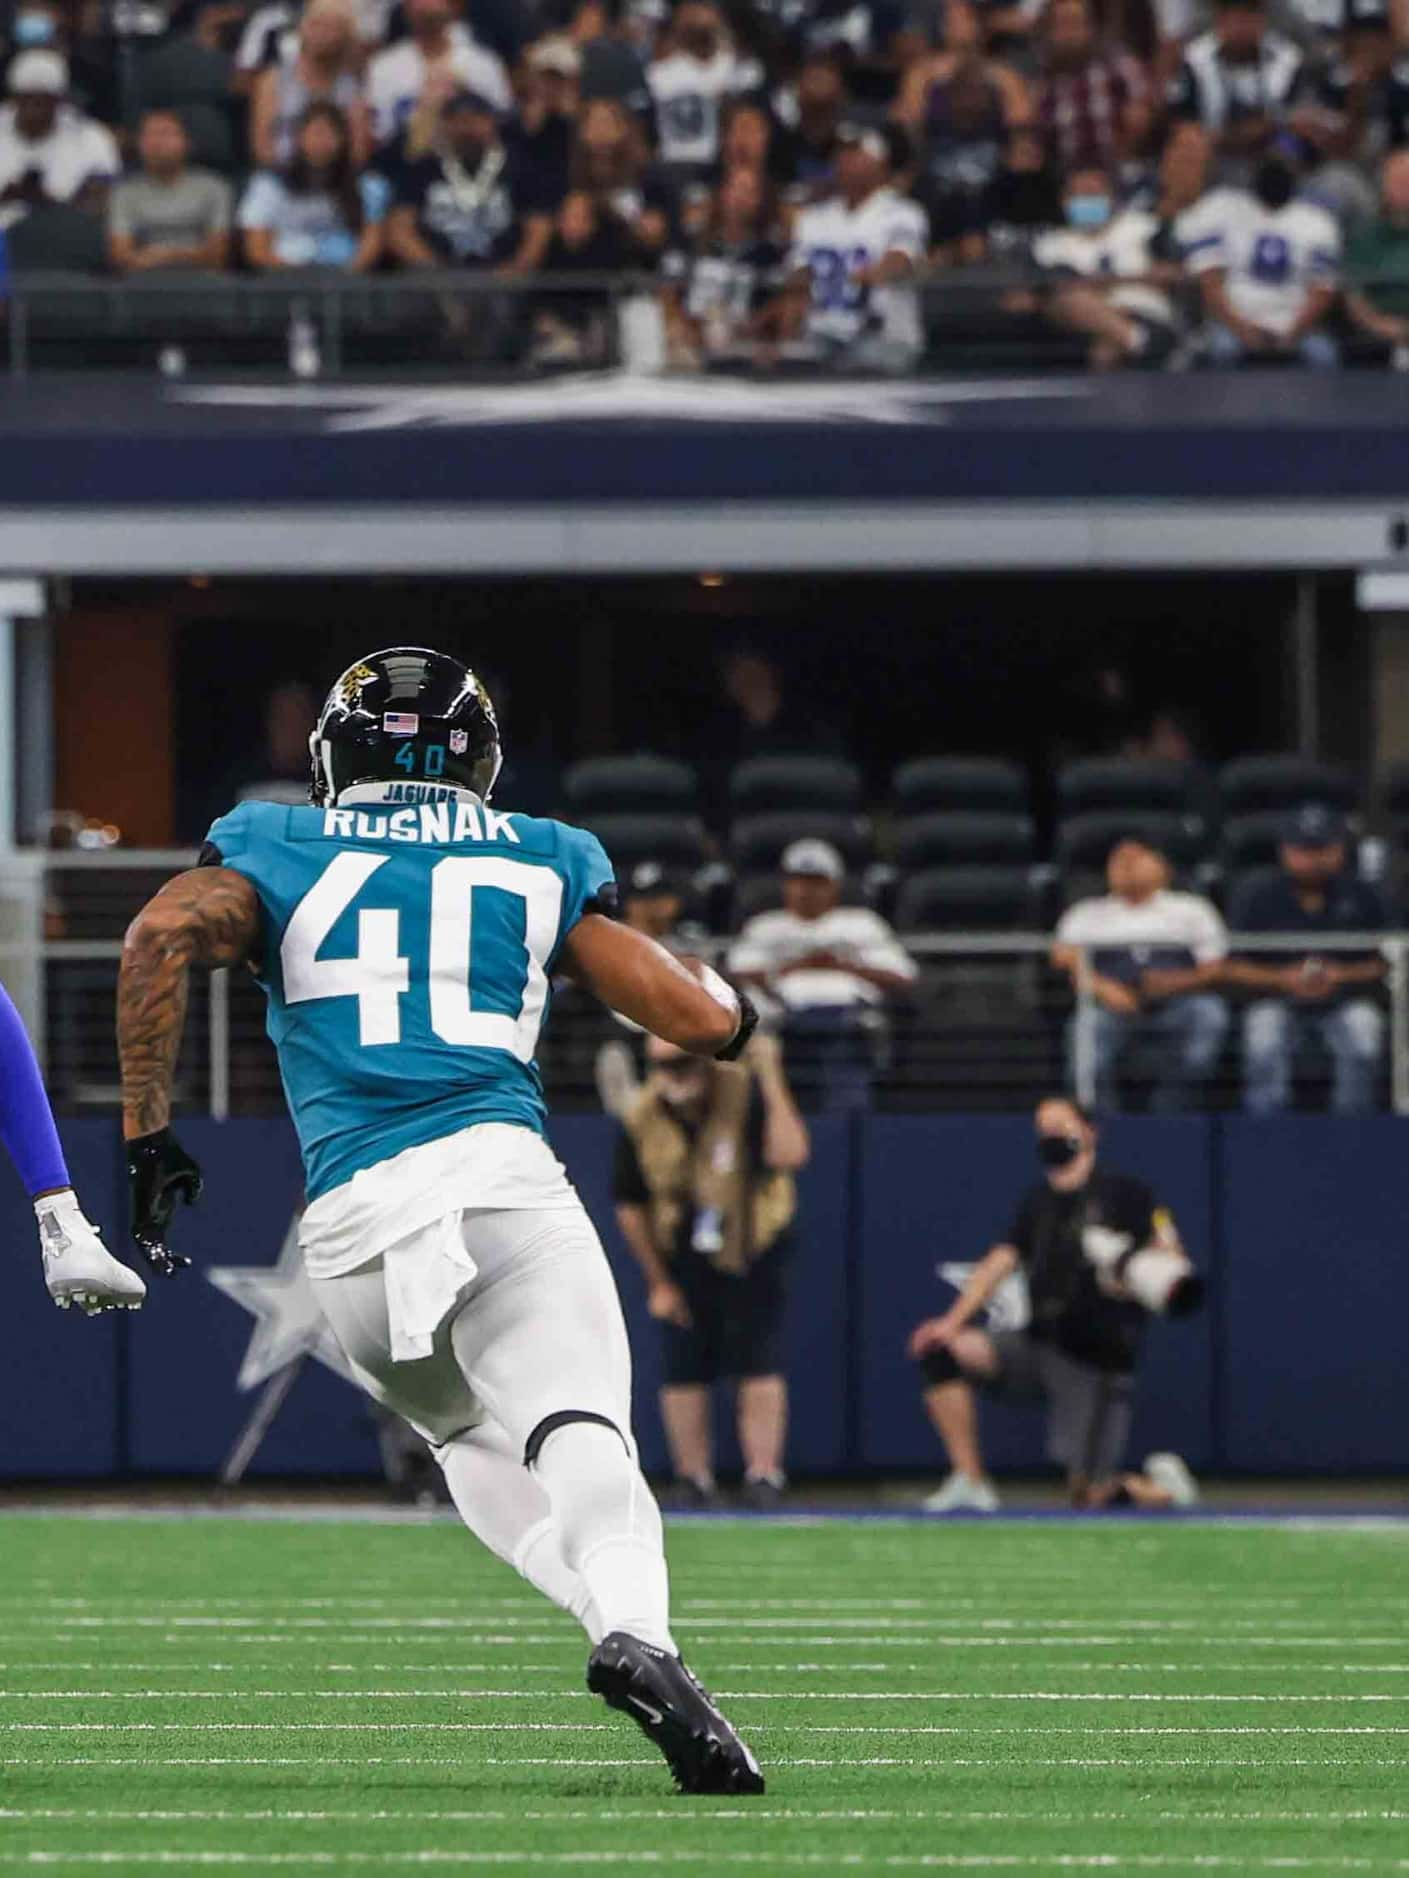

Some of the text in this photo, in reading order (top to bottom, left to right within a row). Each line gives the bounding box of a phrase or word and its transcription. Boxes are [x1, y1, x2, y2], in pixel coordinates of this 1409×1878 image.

[394, 741, 446, 776] 40
[323, 802, 520, 844] RUSNAK
[280, 850, 564, 1065] 40
